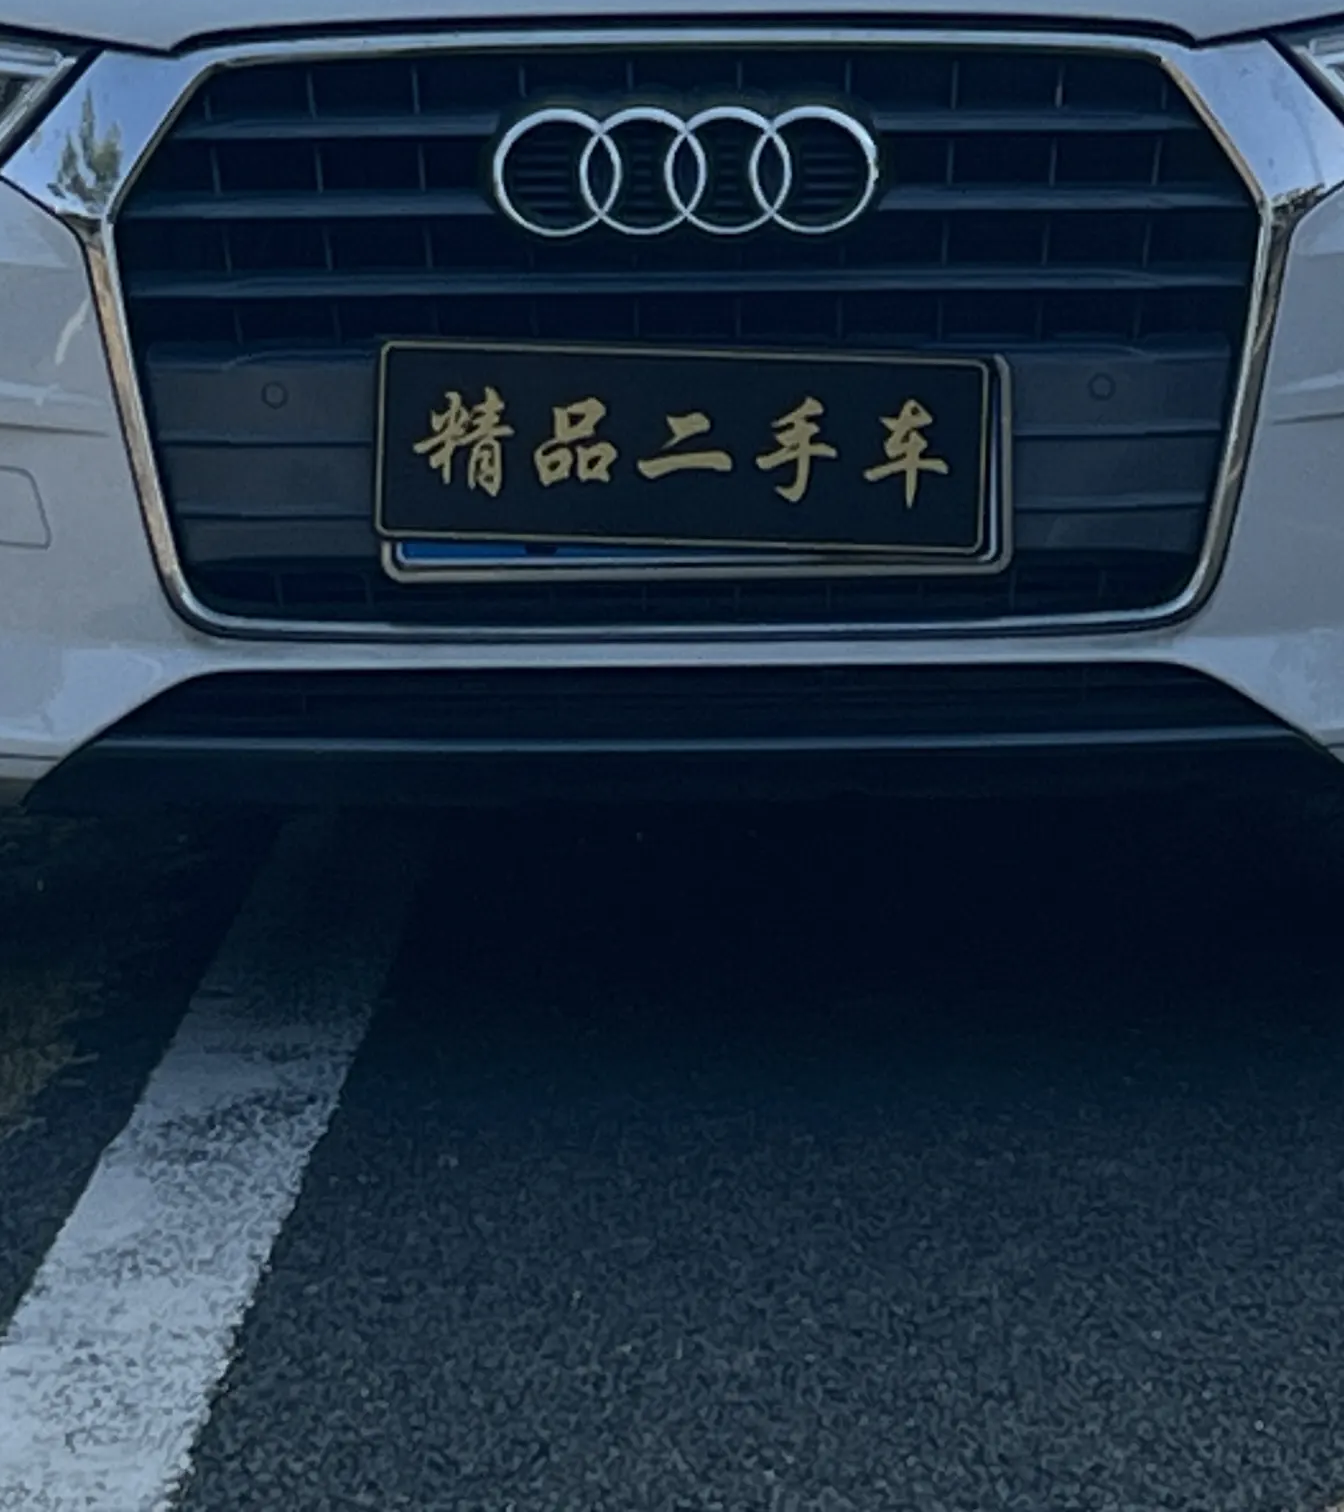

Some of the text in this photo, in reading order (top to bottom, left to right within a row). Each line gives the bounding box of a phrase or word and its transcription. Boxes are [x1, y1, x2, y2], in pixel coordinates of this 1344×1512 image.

[413, 387, 949, 508] 精品二手车
